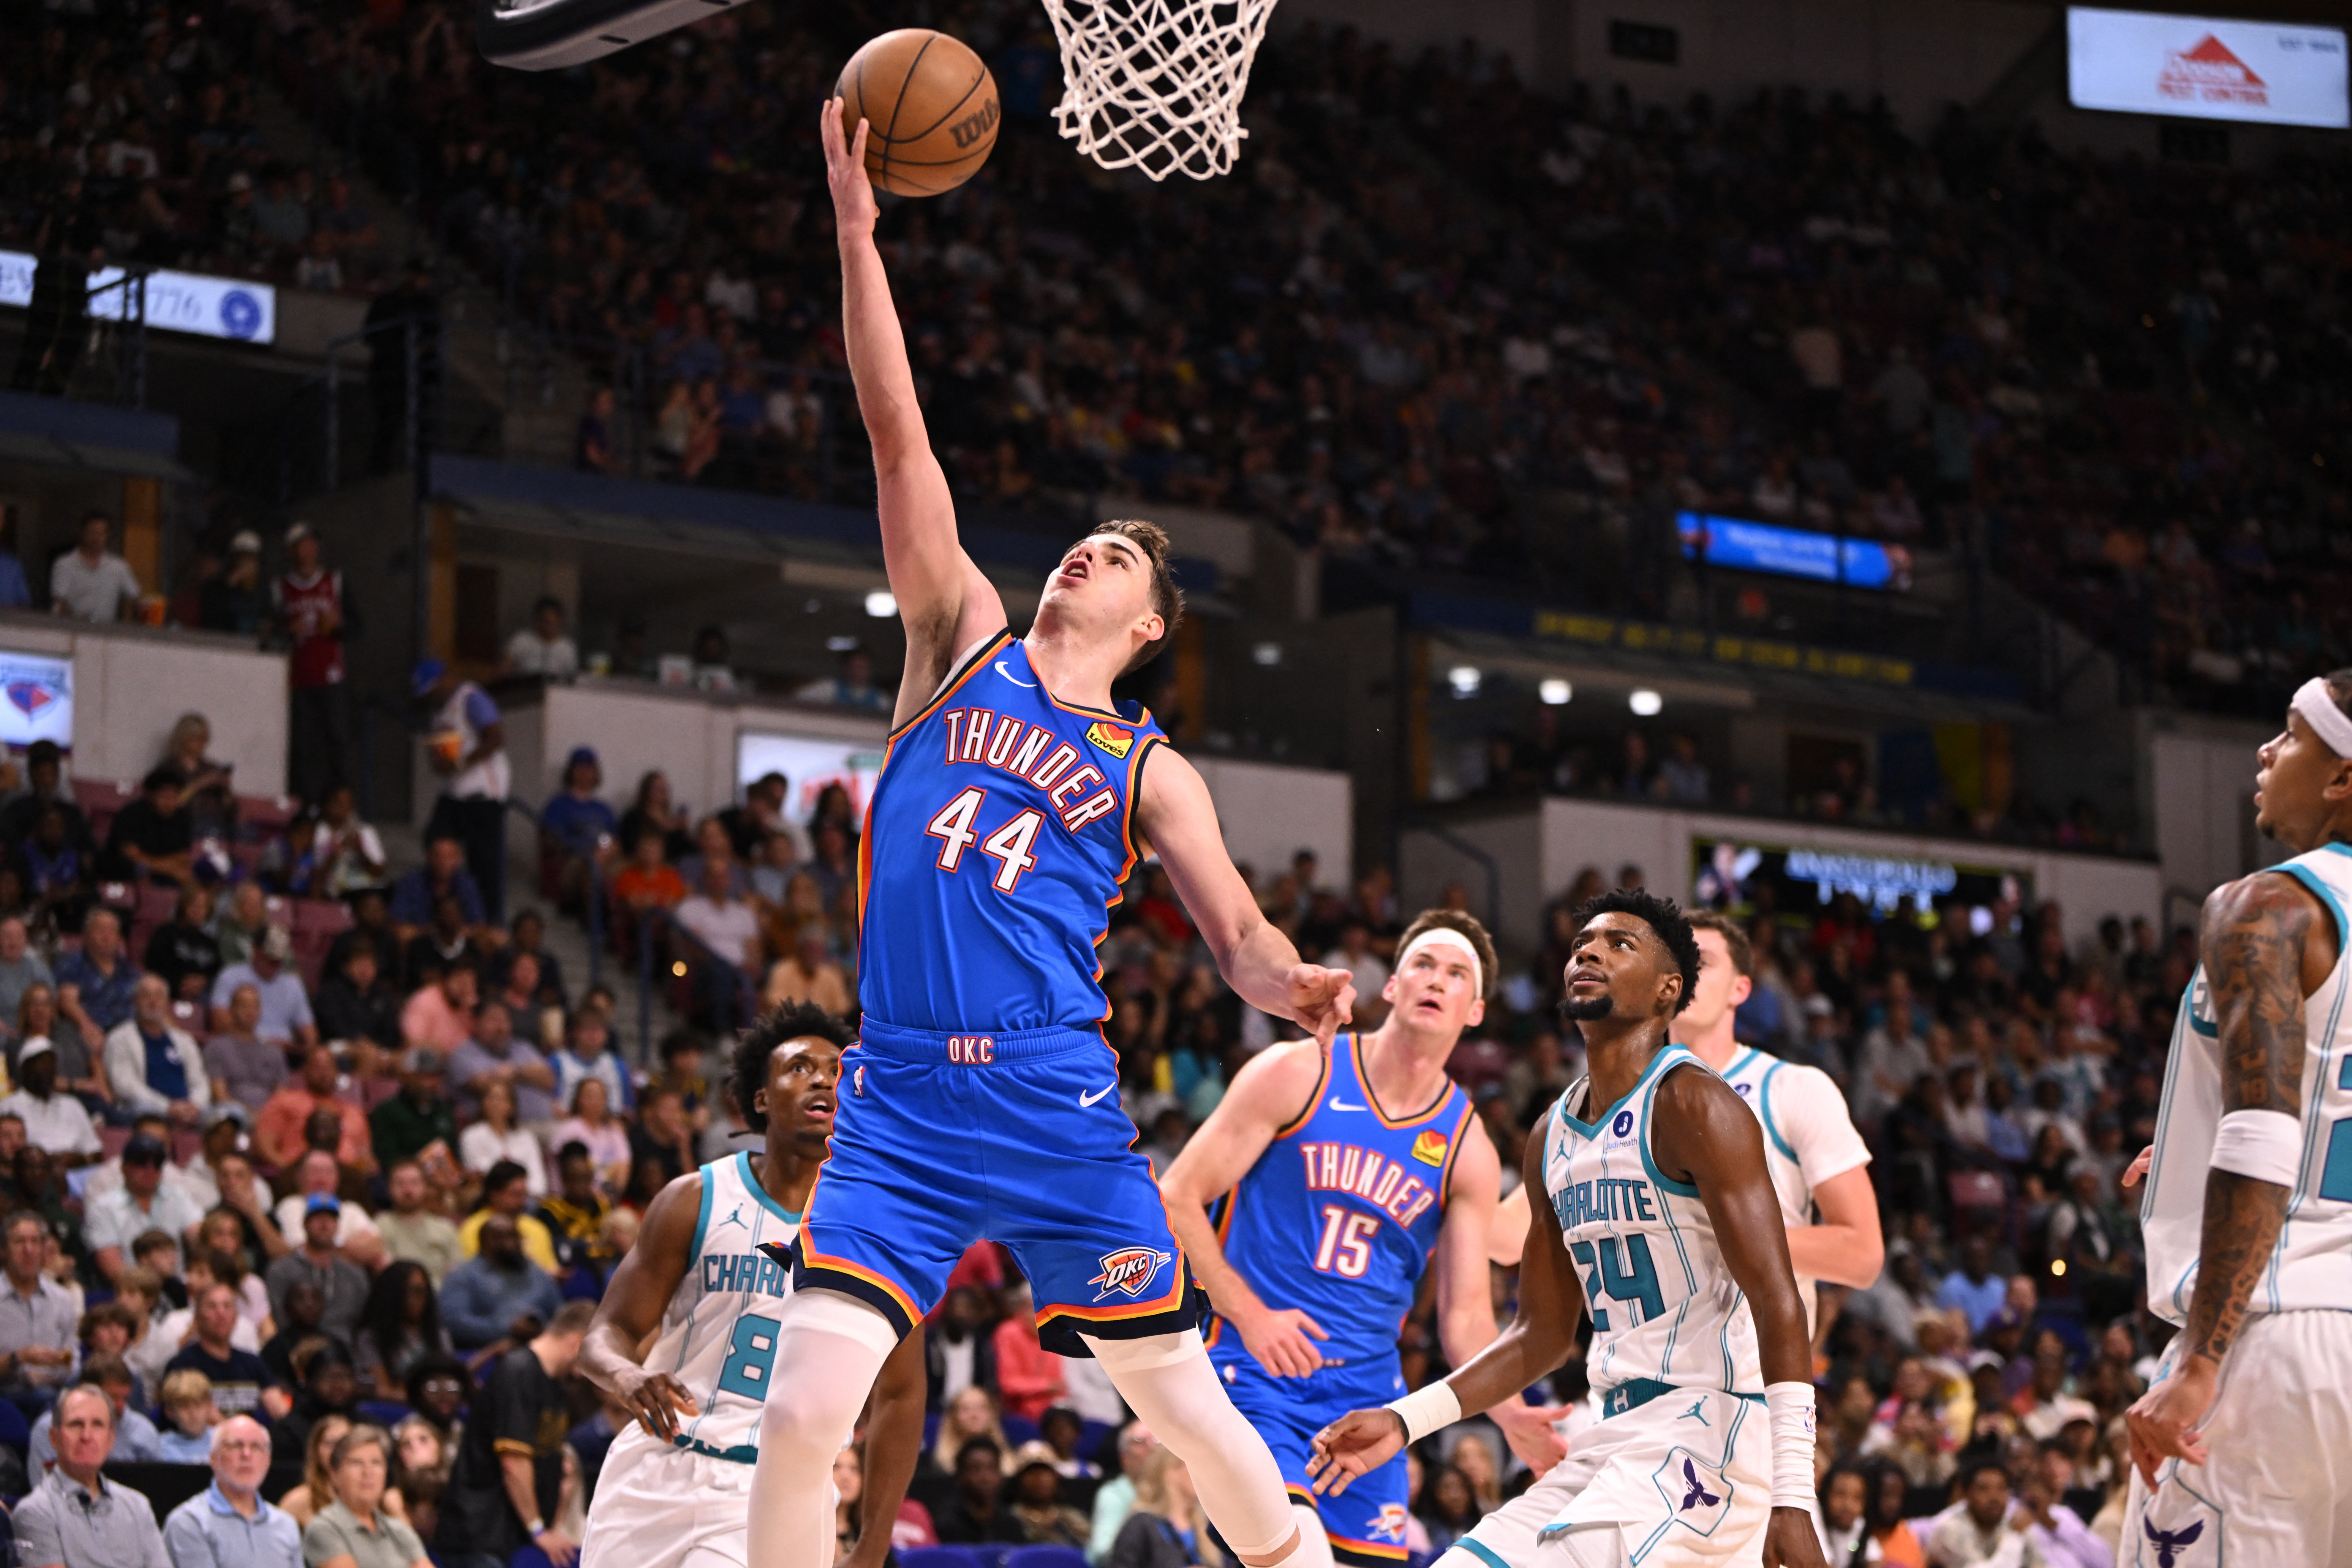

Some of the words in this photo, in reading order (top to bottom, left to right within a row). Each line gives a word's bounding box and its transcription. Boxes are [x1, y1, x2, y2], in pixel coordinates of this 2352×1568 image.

[944, 707, 1118, 835] THUNDER
[925, 786, 1046, 895] 44
[947, 1035, 994, 1064] OKC
[1605, 1140, 1619, 1150] Judi
[1619, 1137, 1638, 1148] Health
[1299, 1142, 1436, 1230] THUNDER
[1551, 1179, 1657, 1232] HARLOTTE
[1105, 1255, 1147, 1289] OKC
[1314, 1203, 1382, 1279] 15
[1570, 1233, 1666, 1332] 24
[718, 1313, 782, 1402] 8
